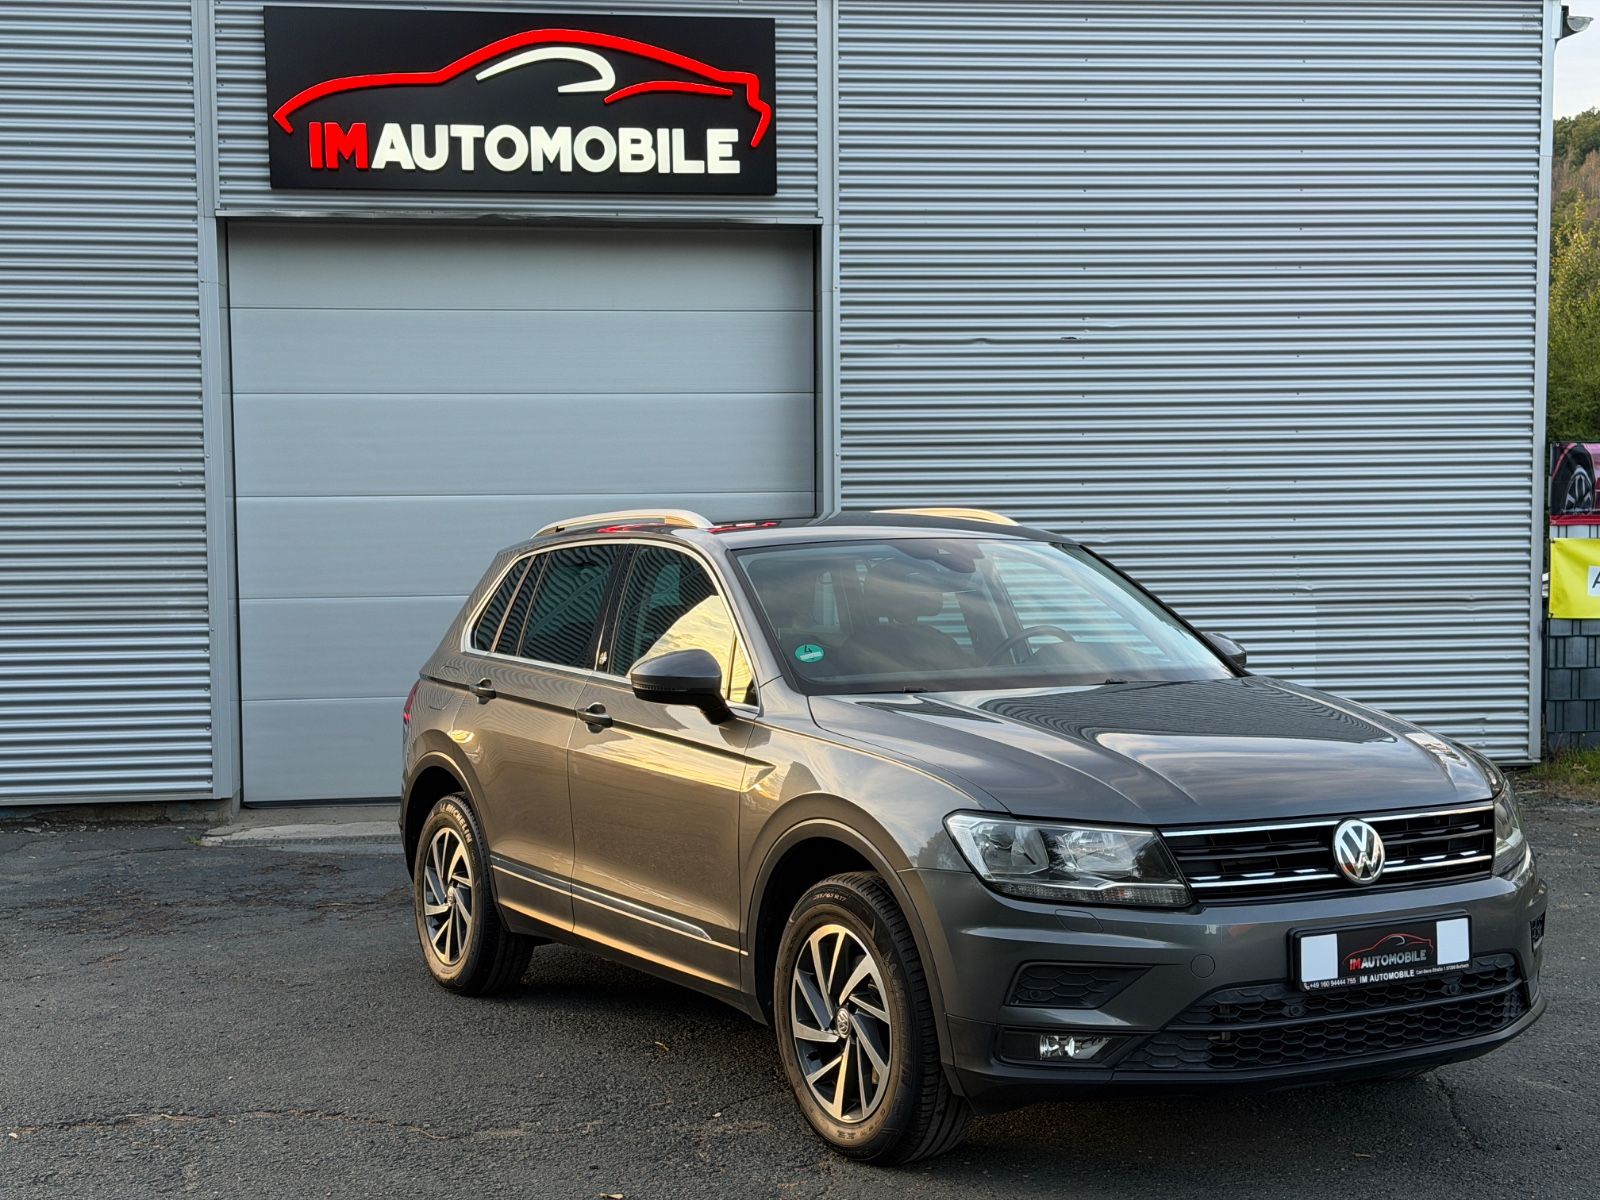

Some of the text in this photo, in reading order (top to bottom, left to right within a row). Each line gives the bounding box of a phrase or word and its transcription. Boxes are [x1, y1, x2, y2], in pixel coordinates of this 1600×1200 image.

[446, 803, 473, 844] MICHELIN
[1359, 975, 1368, 984] IM
[1369, 968, 1415, 983] AUTOMOBILE
